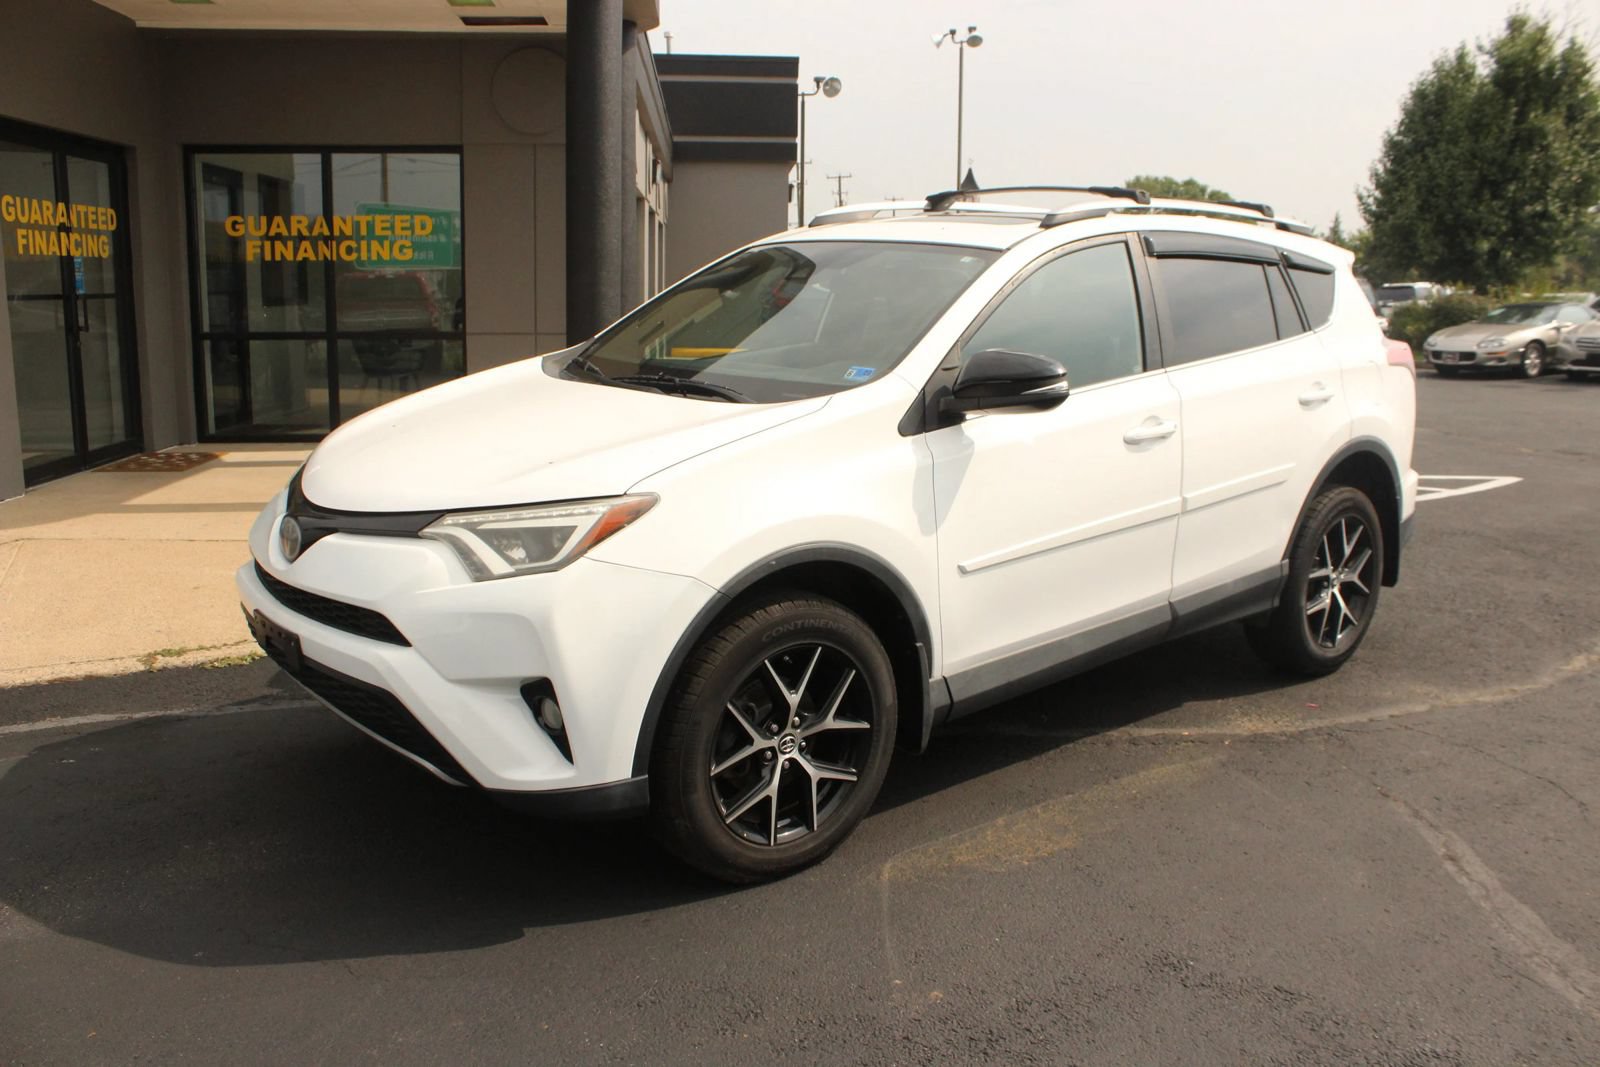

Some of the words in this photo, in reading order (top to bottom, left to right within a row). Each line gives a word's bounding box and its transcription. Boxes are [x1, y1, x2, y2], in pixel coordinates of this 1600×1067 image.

[2, 195, 117, 231] GUARANTEED
[224, 215, 433, 237] GUARANTEED
[16, 229, 110, 258] FINANCING
[246, 240, 414, 261] FINANCING
